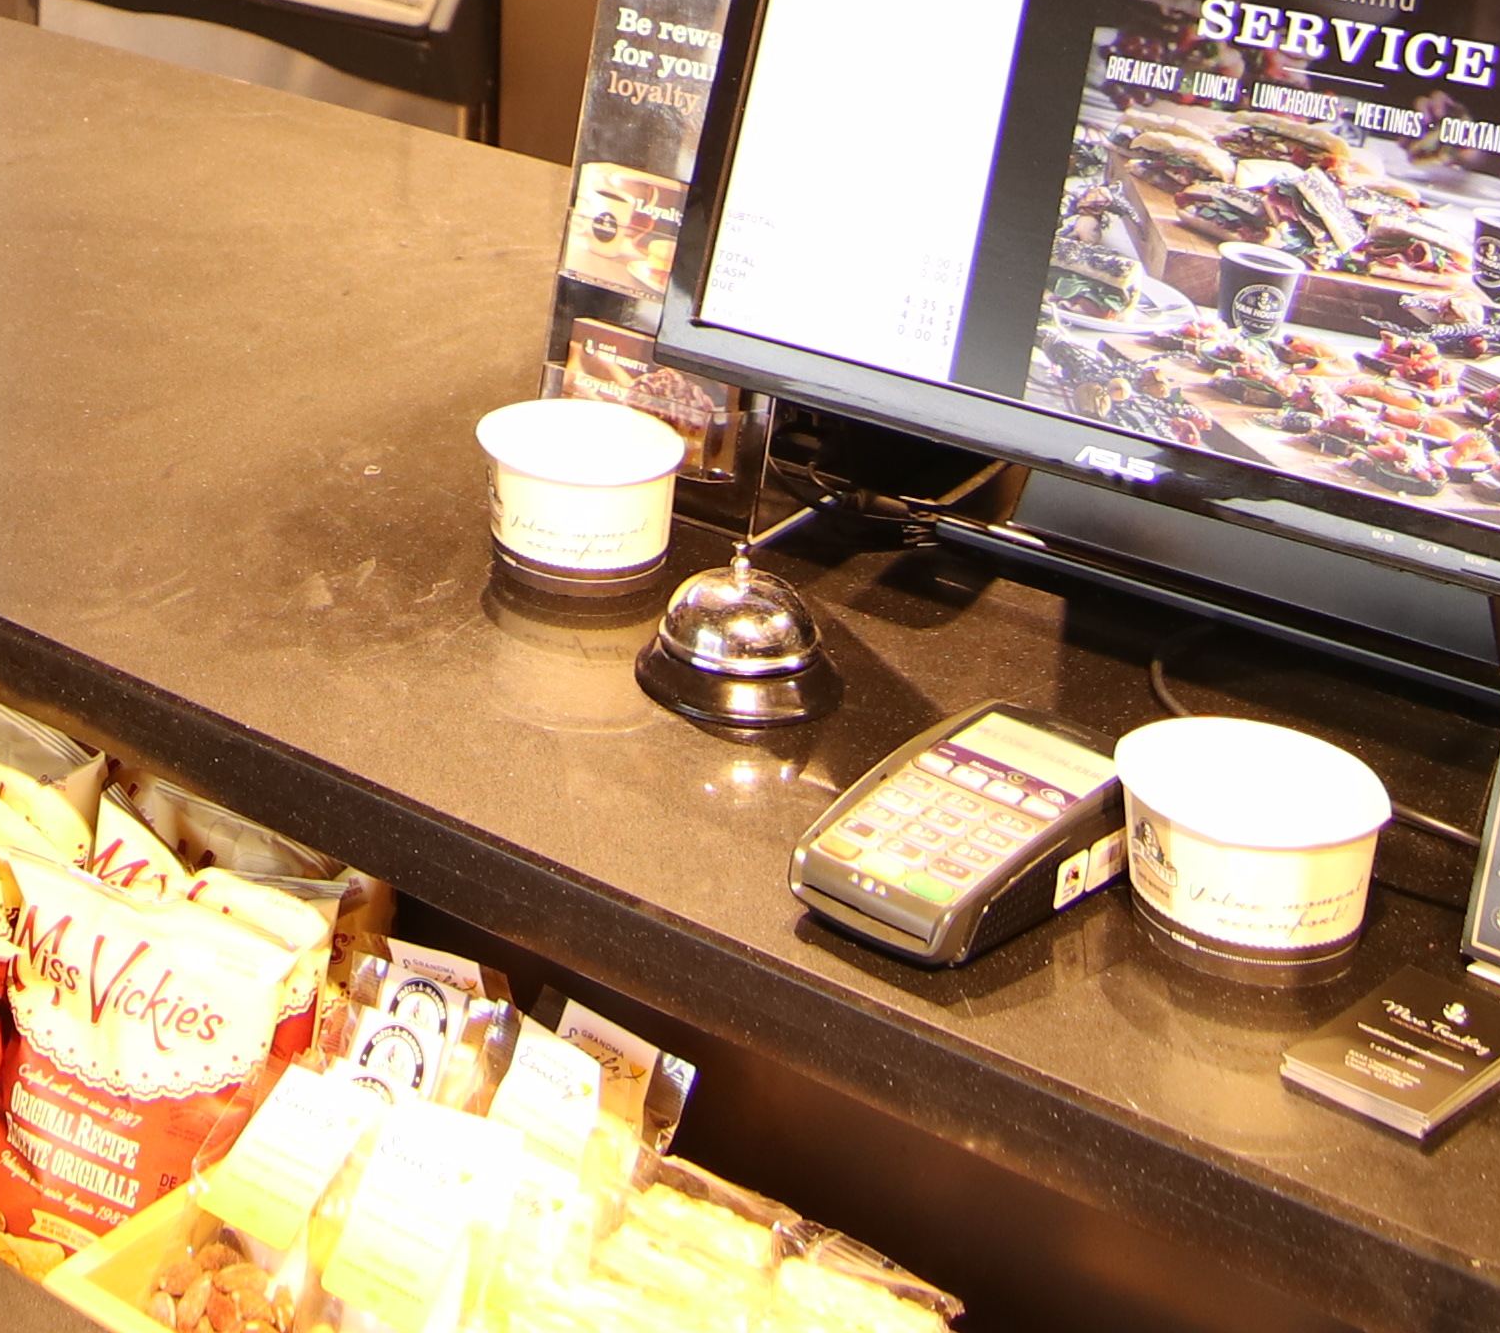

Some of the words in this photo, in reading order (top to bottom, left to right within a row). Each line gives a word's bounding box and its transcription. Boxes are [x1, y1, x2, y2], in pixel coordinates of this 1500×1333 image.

[616, 7, 652, 36] Be
[611, 39, 654, 69] for
[607, 70, 700, 116] loyalty
[1105, 55, 1178, 92] BREAKFAST
[1192, 71, 1237, 104] LUNCH
[1251, 82, 1338, 124] LUNCHBOXES
[1354, 101, 1424, 139] MEETINGS
[714, 264, 747, 279] CASH
[718, 249, 756, 268] TOTAL
[711, 277, 734, 293] DUE
[1074, 443, 1158, 486] ASUS
[10, 904, 80, 1006] Miss
[90, 934, 225, 1052] Vickie's
[581, 1028, 626, 1059] GRANDMA
[10, 1081, 74, 1144] ORIGINAL
[74, 1117, 140, 1170] RECIPE
[110, 1107, 142, 1128] 1987
[51, 1150, 140, 1209] ORIGINALE
